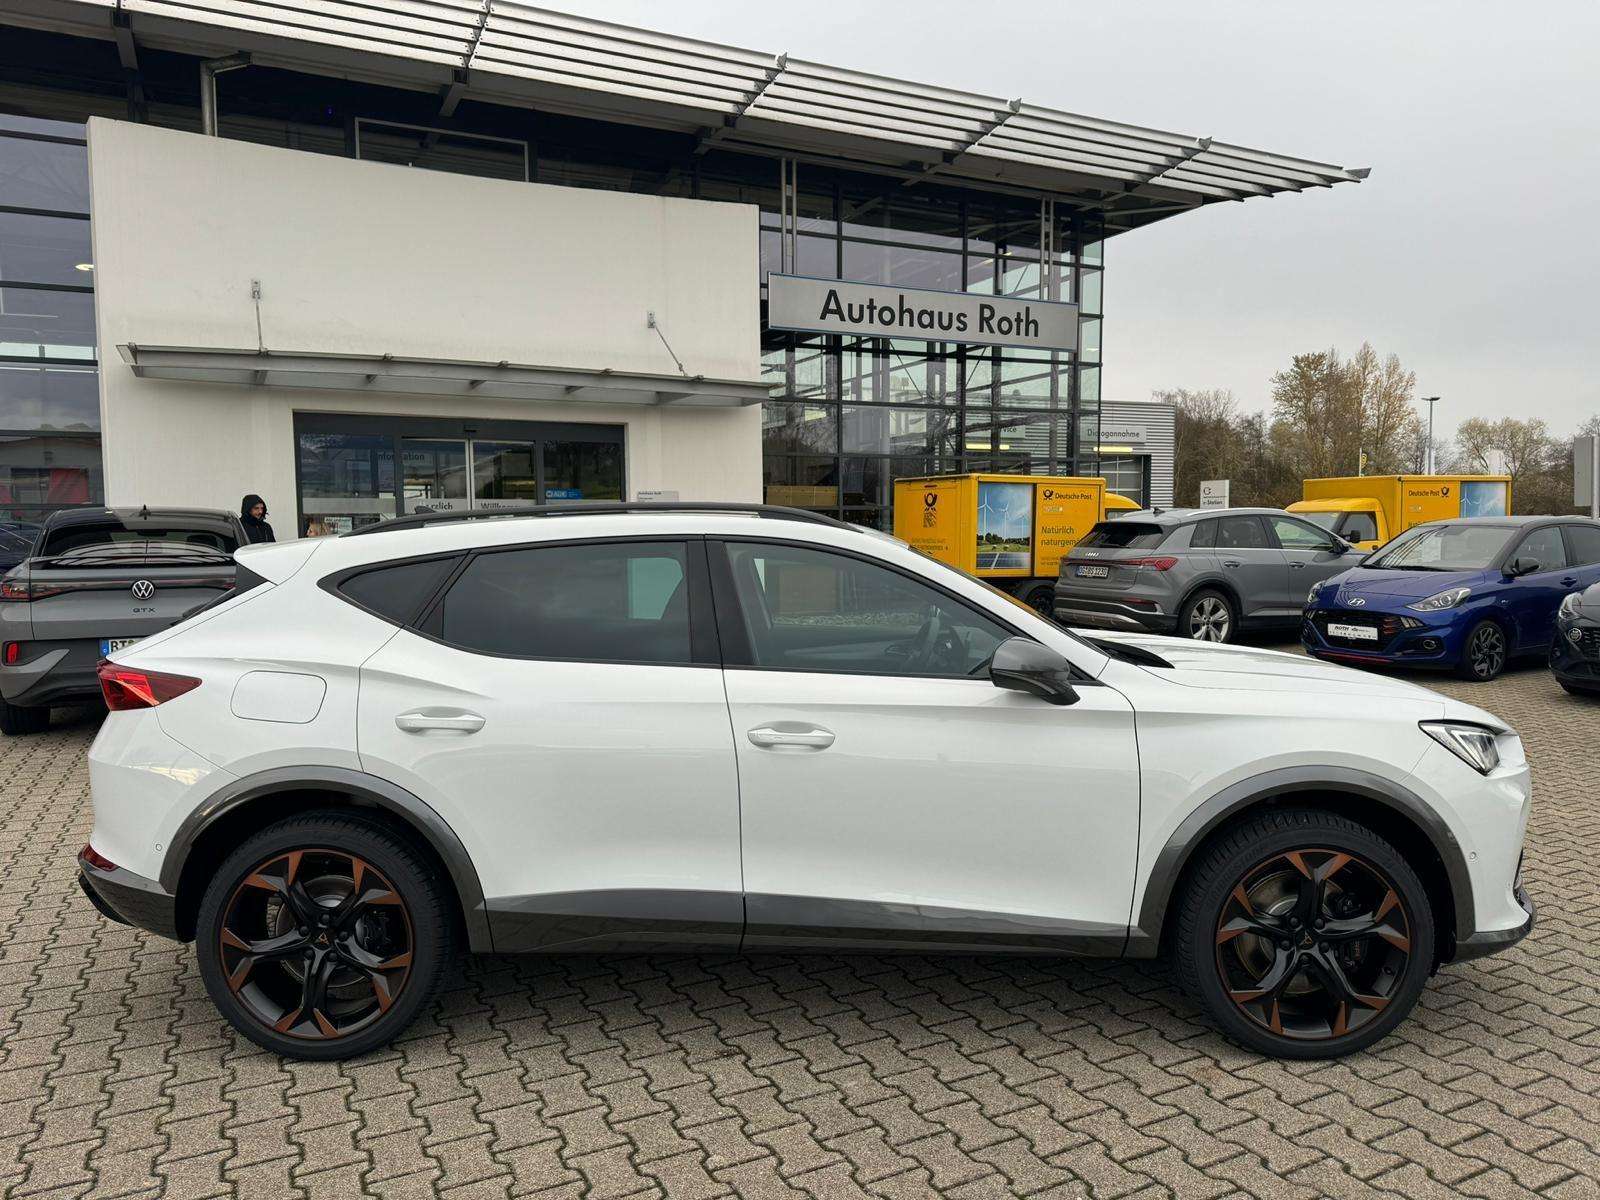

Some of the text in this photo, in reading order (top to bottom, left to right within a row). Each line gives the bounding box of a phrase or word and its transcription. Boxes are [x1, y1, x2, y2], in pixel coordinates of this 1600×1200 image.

[819, 288, 1039, 337] Autohaus Roth
[1087, 428, 1140, 439] Diaogannahme
[1055, 492, 1079, 500] Deutsche
[1041, 525, 1075, 534] Natürlich
